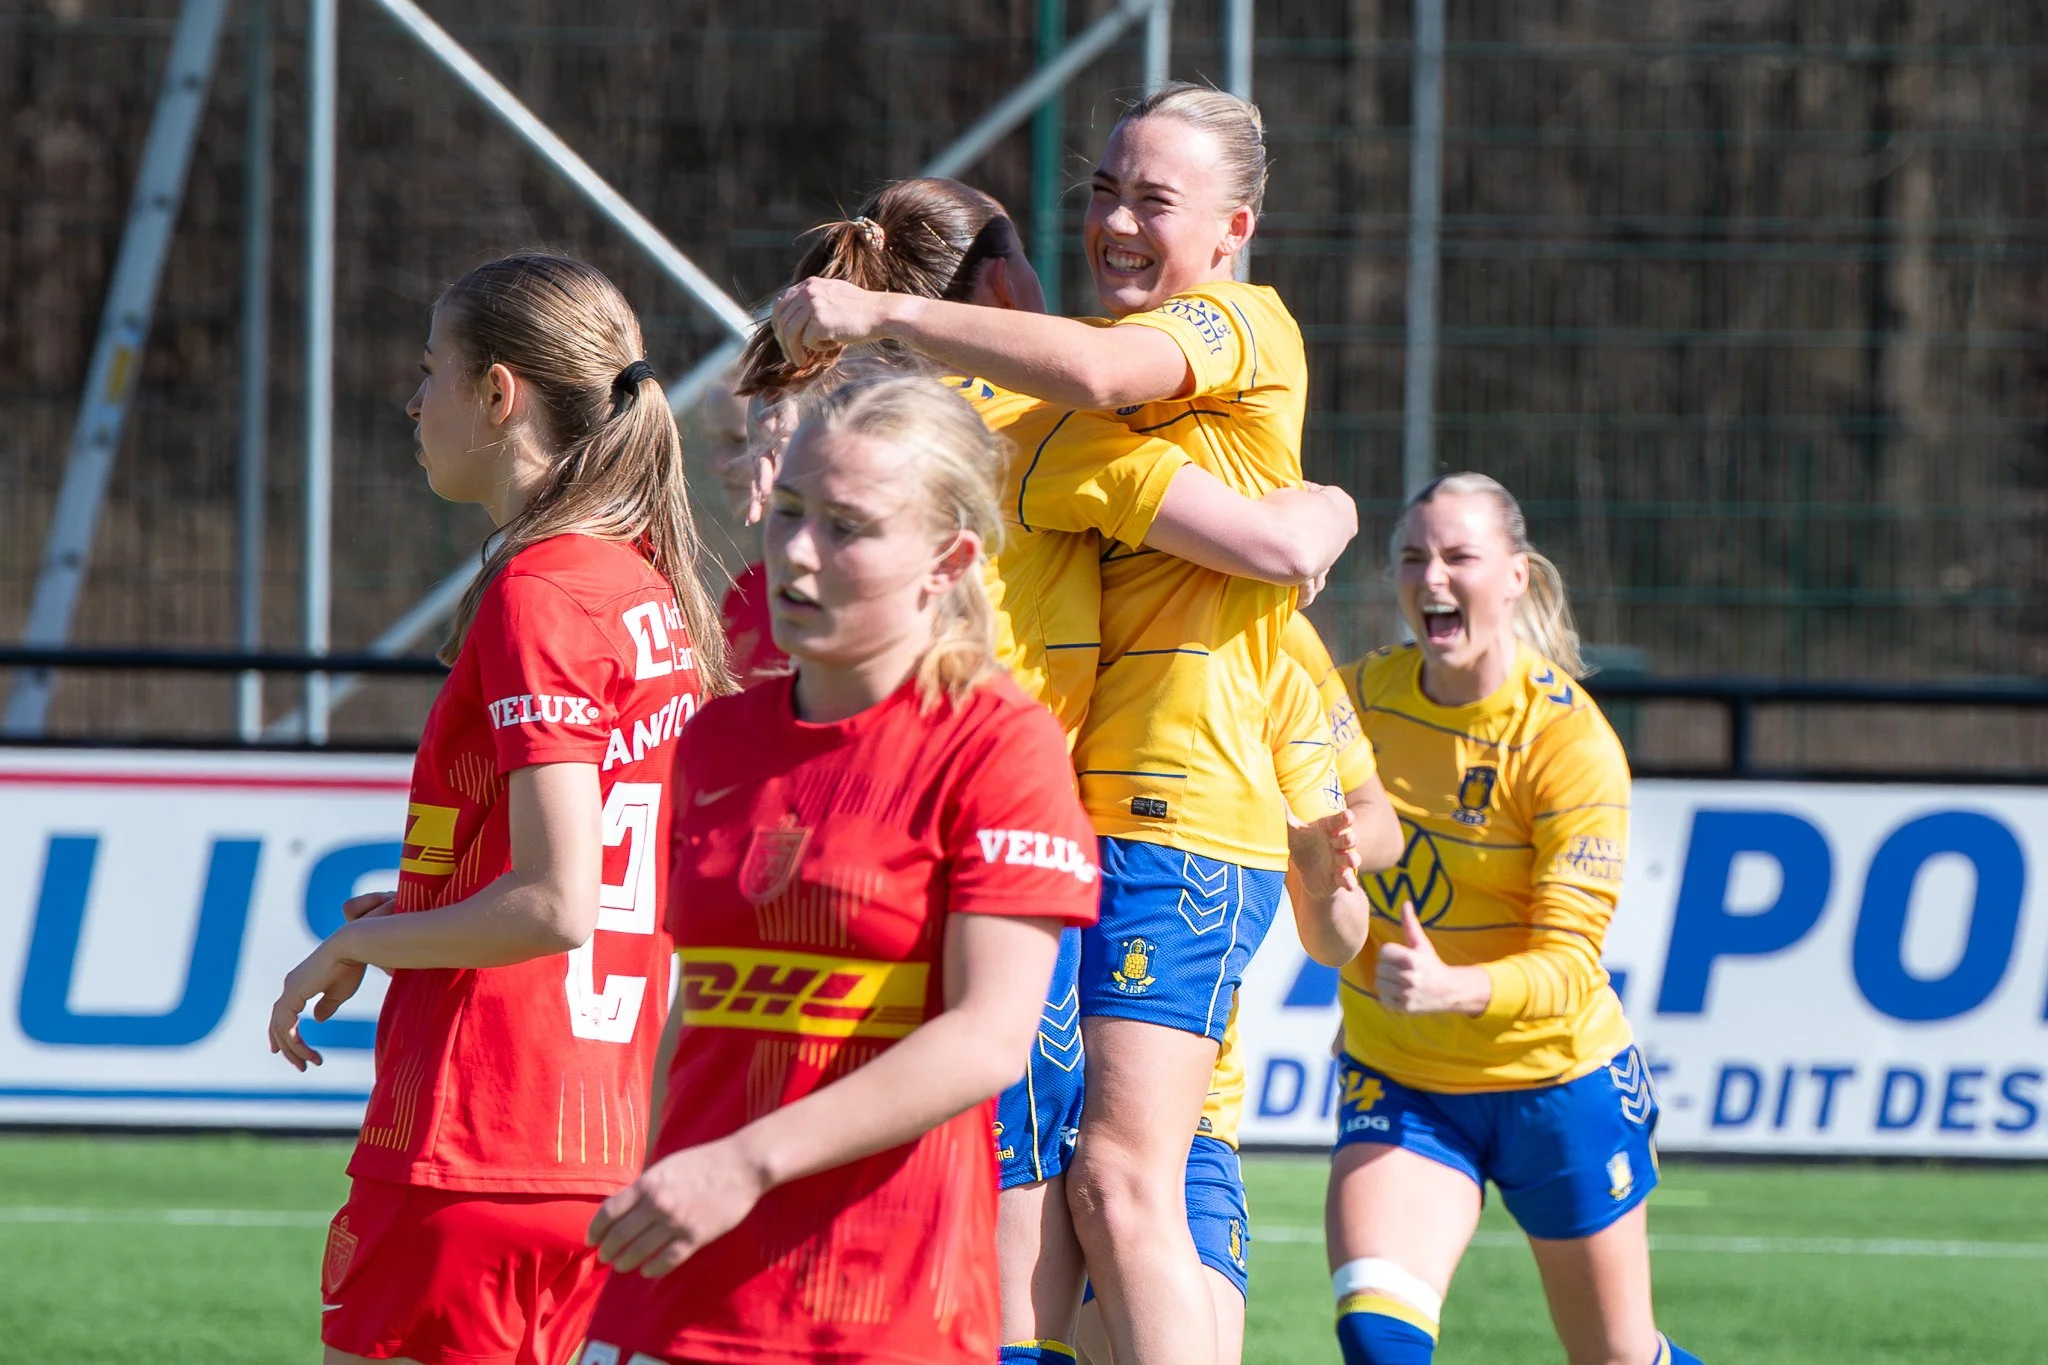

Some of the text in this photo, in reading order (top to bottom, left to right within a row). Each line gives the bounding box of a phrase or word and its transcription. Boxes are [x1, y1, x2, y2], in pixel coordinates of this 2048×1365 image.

[602, 692, 701, 771] ANTIO
[565, 782, 680, 1044] 2
[1711, 1063, 1856, 1129] DIT
[1876, 1068, 2044, 1134] DES
